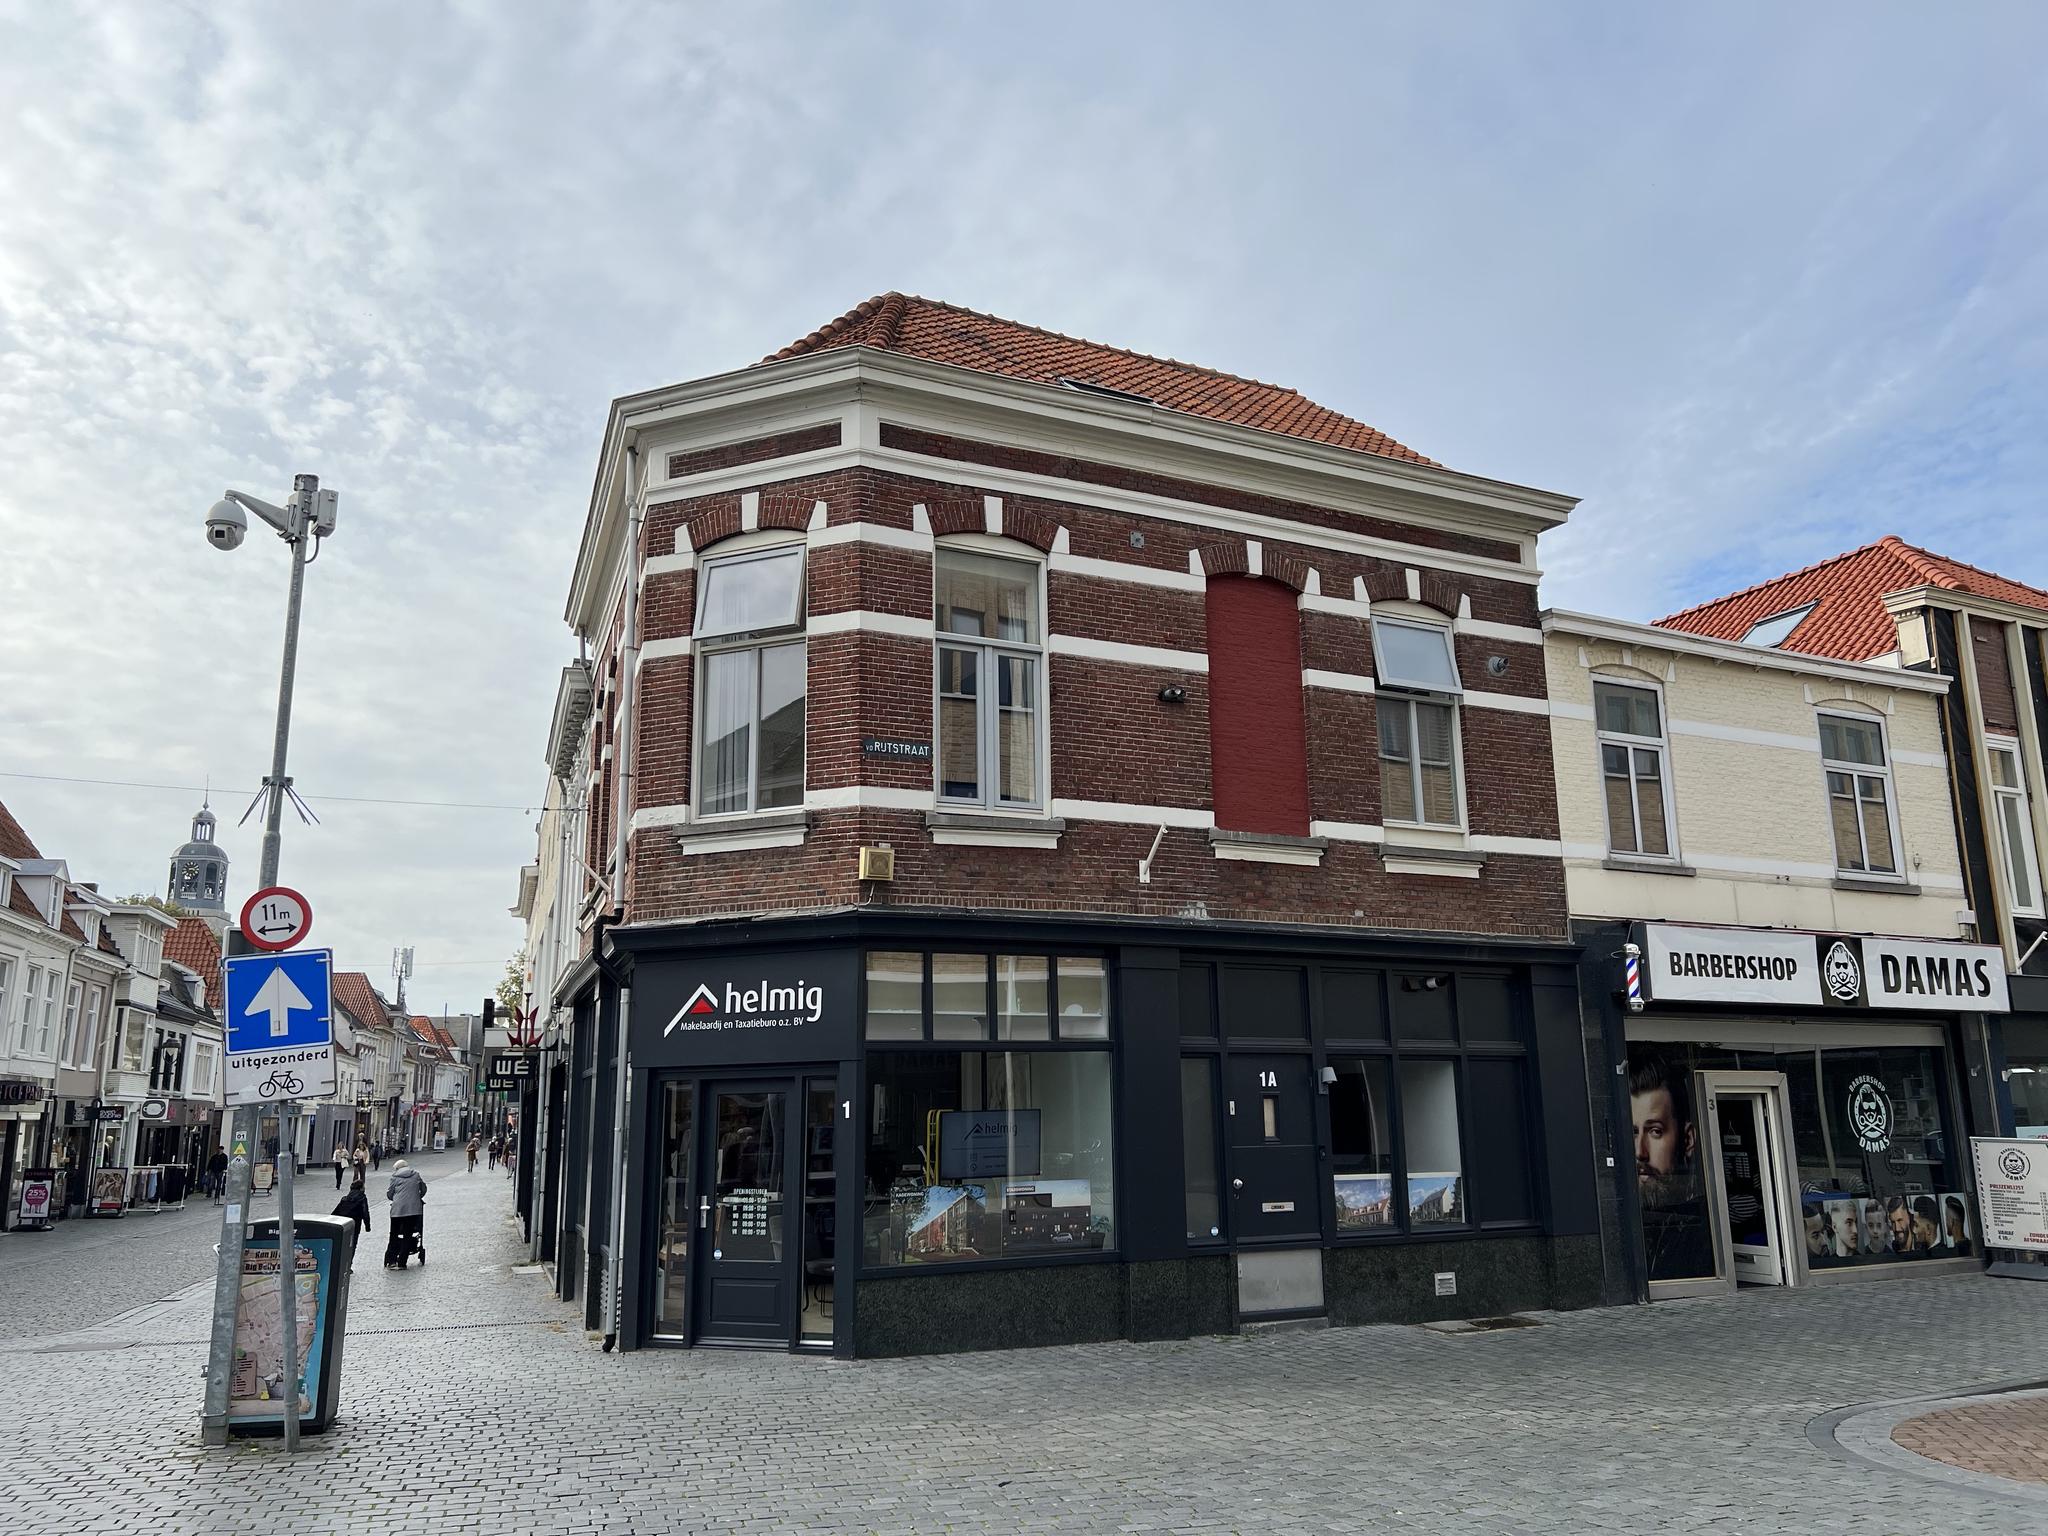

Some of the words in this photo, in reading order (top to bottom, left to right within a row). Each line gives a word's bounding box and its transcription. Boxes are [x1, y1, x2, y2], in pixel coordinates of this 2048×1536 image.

[1669, 951, 1798, 981] BARBERSHOP
[1880, 954, 1991, 998] DAMAS
[724, 980, 823, 1022] helmig
[680, 1020, 722, 1032] Makelaardij
[735, 1018, 777, 1029] Taxatieburo
[778, 1018, 792, 1026] o.z.
[794, 1016, 804, 1026] BV
[232, 1048, 329, 1070] uitgezonderd
[496, 1060, 530, 1075] WE
[1259, 1072, 1278, 1087] 1A
[1848, 1075, 1886, 1092] BARBERSHOP
[842, 1100, 850, 1119] 1
[1708, 1099, 1715, 1110] 3
[984, 1122, 1018, 1137] helmig
[1859, 1136, 1890, 1152] DAMAS
